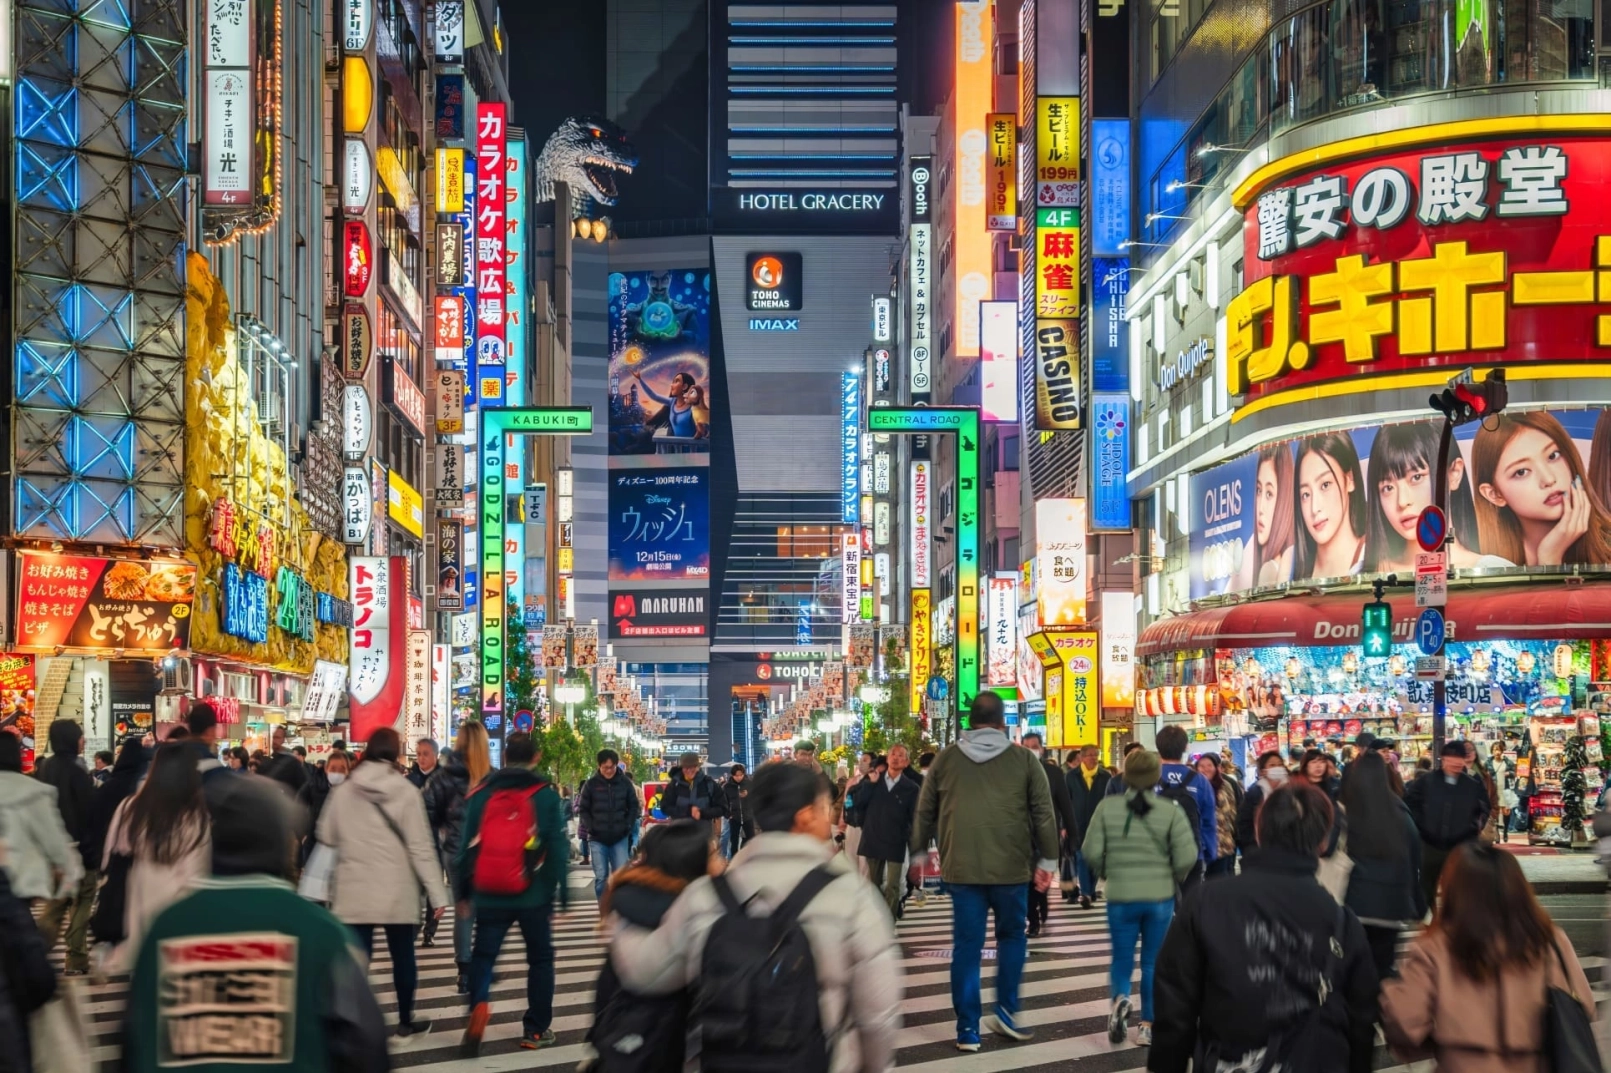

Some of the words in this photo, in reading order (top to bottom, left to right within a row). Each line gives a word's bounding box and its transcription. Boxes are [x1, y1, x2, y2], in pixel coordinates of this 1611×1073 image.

[346, 38, 364, 48] 6F
[441, 5, 457, 50] ダーツ
[224, 100, 233, 148] チキン酒場
[1048, 103, 1063, 162] 生ビール
[994, 120, 1006, 167] 生ビール
[220, 153, 237, 172] 光
[960, 128, 988, 206] Booth
[1040, 166, 1078, 180] 199円
[221, 191, 236, 203] 4F
[350, 187, 360, 197] 光
[740, 194, 798, 209] HOTEL
[801, 194, 884, 209] GRACERY
[912, 167, 930, 215] Booth
[997, 170, 1007, 212] 199円
[1258, 146, 1568, 260] 驚安の殿堂
[479, 112, 502, 325] カラオケ歌広場
[1045, 210, 1072, 226] 4F
[441, 227, 457, 276] 山内農場
[916, 229, 926, 284] ネットカフェ
[1043, 232, 1075, 291] 麻雀
[752, 291, 779, 299] TOHO
[752, 300, 790, 308] CINEMAS
[917, 289, 925, 298] &
[1040, 294, 1069, 304] スリー
[1109, 268, 1118, 348] SHISHA
[750, 319, 798, 330] IMAX
[878, 306, 887, 337] 東京ビル
[916, 302, 926, 340] カプセル
[1039, 305, 1077, 315] ファイブ
[351, 316, 362, 371] お好み焼き
[1038, 326, 1078, 423] CASINO
[1161, 364, 1176, 392] Don
[1177, 339, 1208, 380] Quijote
[484, 380, 498, 396] 薬
[844, 379, 858, 419] 747
[442, 421, 456, 430] 3F
[874, 416, 927, 424] CENTRAL
[930, 416, 960, 424] ROAD
[349, 452, 361, 460] 1F
[845, 425, 857, 517] カラオケランド
[1102, 443, 1111, 487] STAGE
[1112, 443, 1121, 477] IDOL
[437, 490, 462, 500] 大阪家
[617, 475, 699, 486] ディズニー100周年記念
[915, 473, 926, 515] カラオケ
[347, 482, 364, 524] かっぱ
[644, 494, 672, 506] Disney
[1101, 501, 1120, 513] 5F
[1205, 479, 1242, 524] OLENS
[349, 529, 361, 537] B1
[485, 456, 500, 600] GODZILLA
[622, 502, 695, 543] ウィッシュ
[442, 525, 456, 563] 海の家
[915, 526, 927, 586] まねきねこ
[27, 563, 89, 580] お好み焼き
[375, 559, 387, 608] 大衆酒場
[961, 476, 976, 669] ゴジラロード
[1053, 567, 1075, 577] 放題
[27, 583, 89, 599] もんじゃ焼き
[846, 551, 858, 624] 新宿東宝ビル
[24, 601, 74, 617] 焼きそば
[98, 604, 131, 612] お好み焼き
[174, 606, 187, 615] 2F
[354, 565, 374, 649] トラノコ
[642, 597, 704, 614] MARUHAN
[24, 621, 49, 635] ピザ
[88, 603, 178, 642] とらぢゅう
[996, 619, 1008, 644] 九十九
[1314, 621, 1359, 639] Don
[1421, 620, 1433, 648] P
[485, 617, 500, 685] ROAD
[1055, 638, 1095, 648] カラオケ
[1429, 635, 1437, 648] 40
[370, 649, 384, 683] やきとり
[774, 667, 810, 677] TOHO
[1074, 677, 1087, 738] 持込OK!
